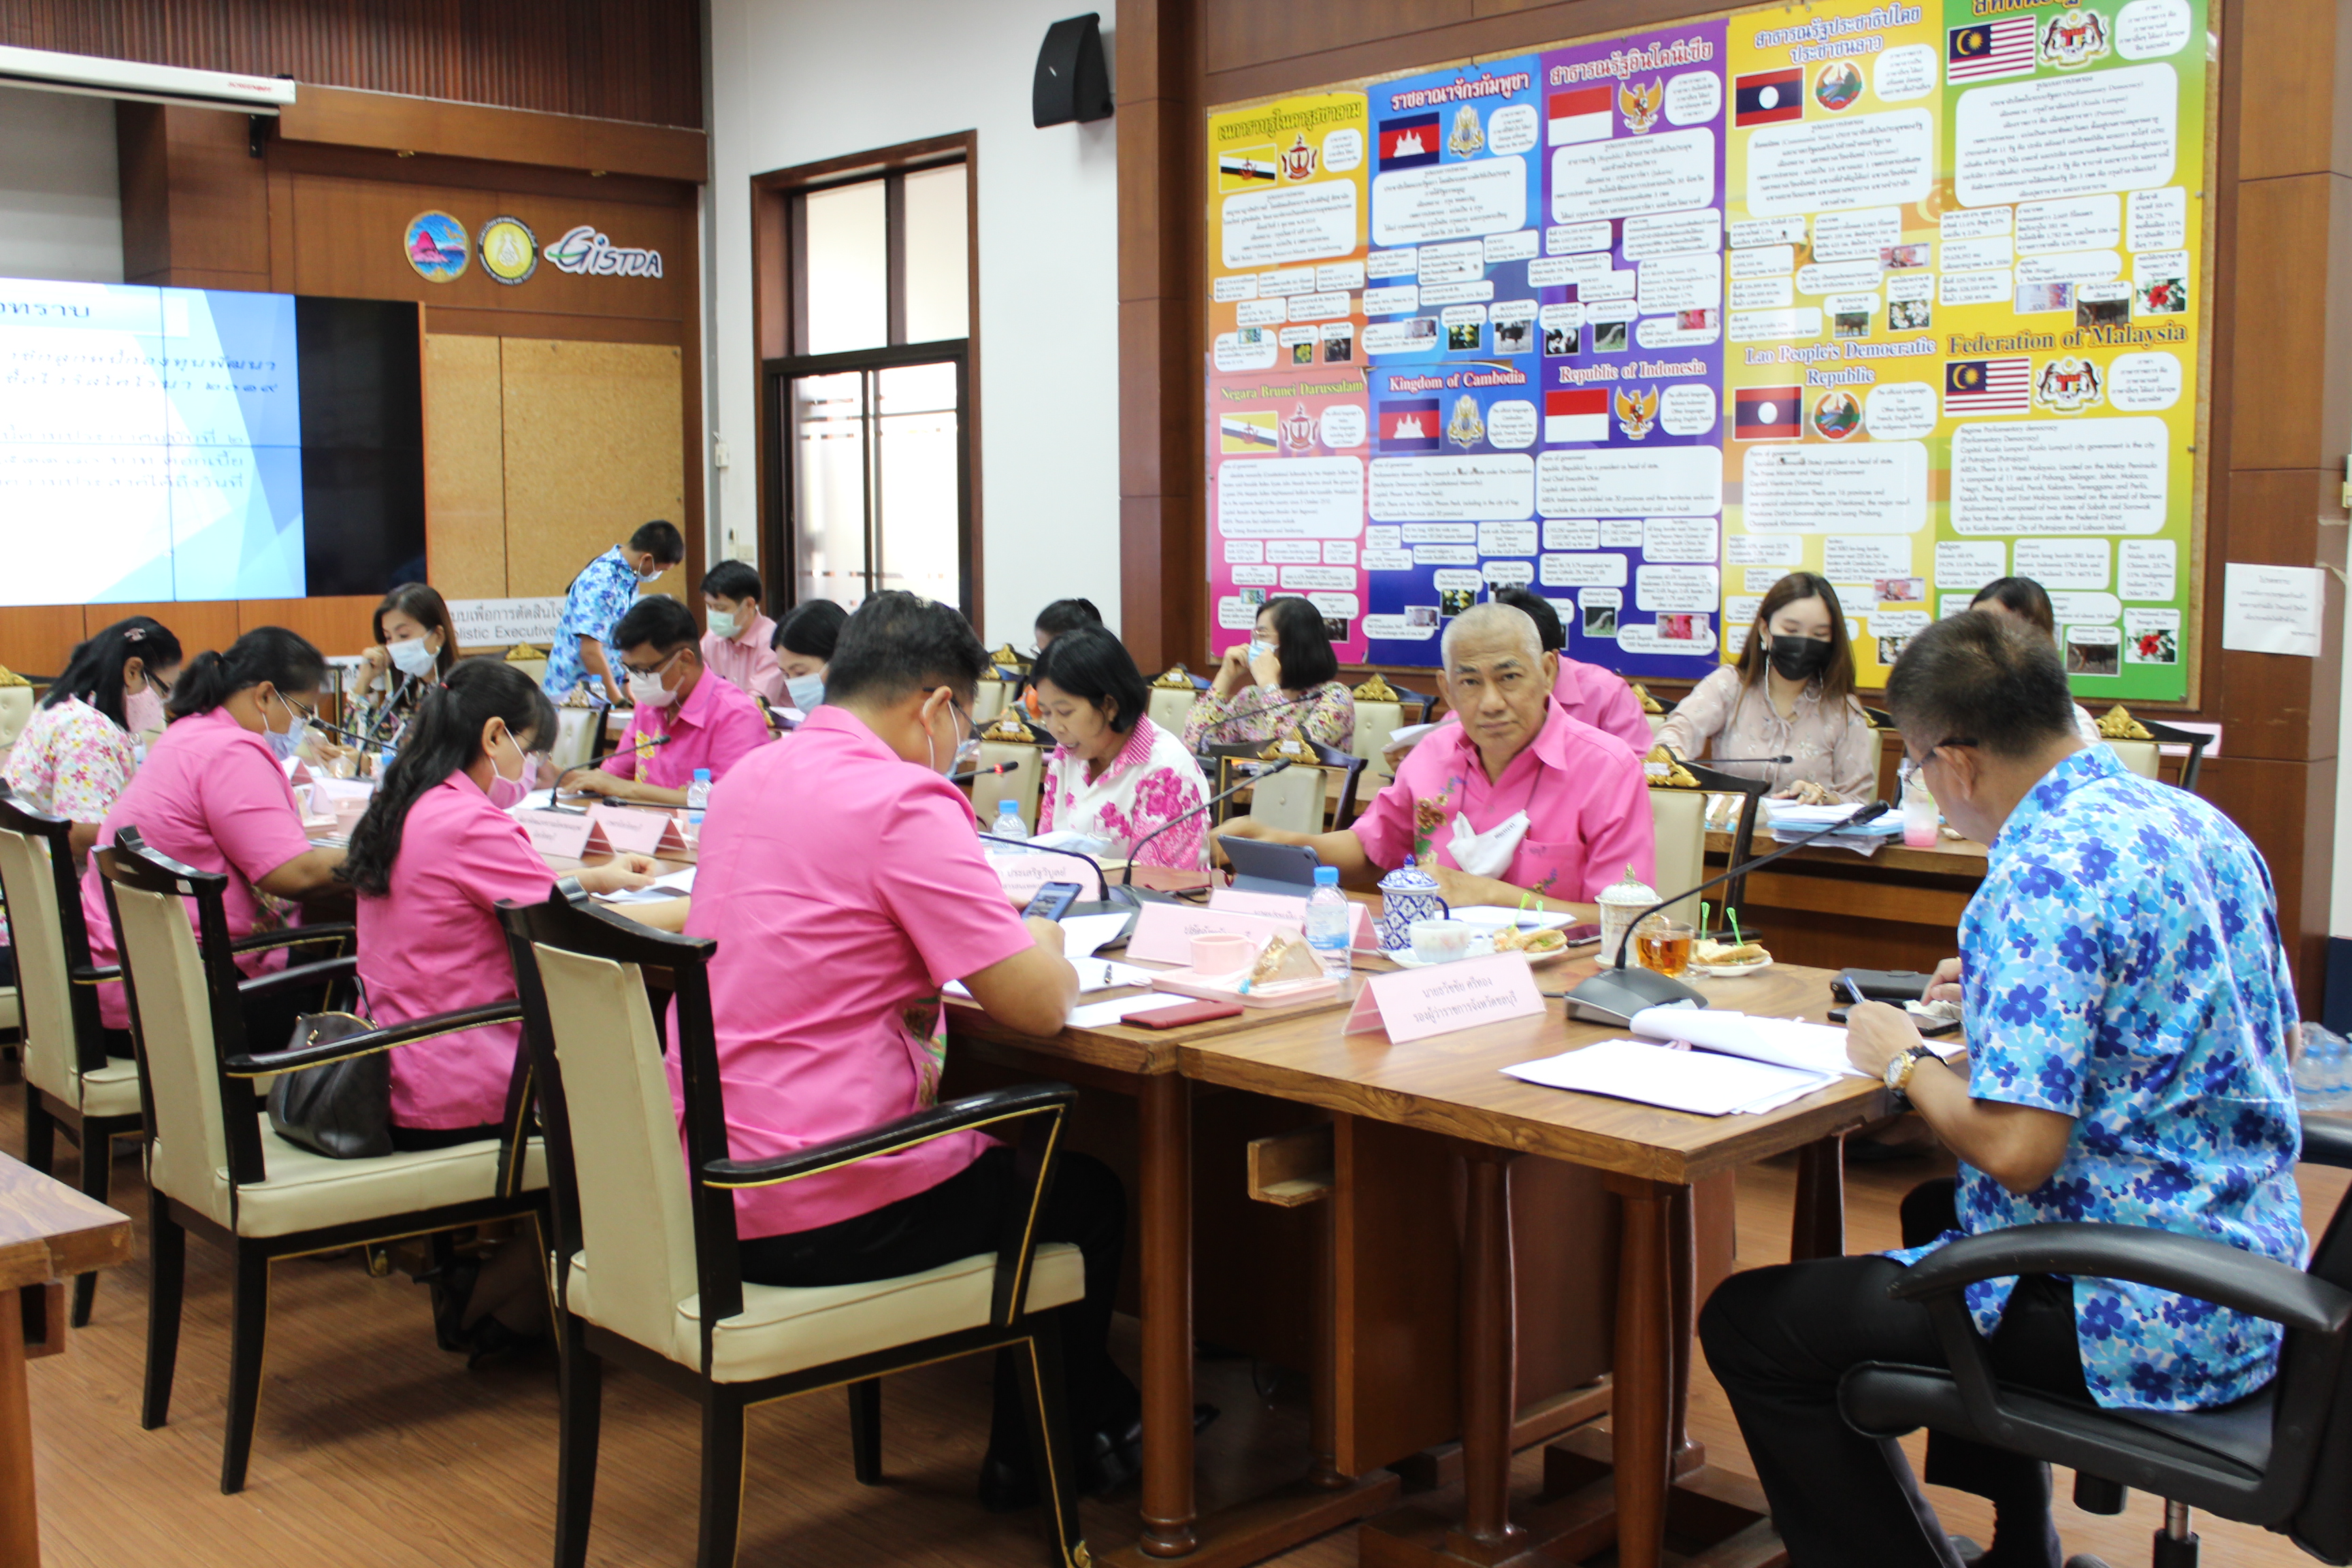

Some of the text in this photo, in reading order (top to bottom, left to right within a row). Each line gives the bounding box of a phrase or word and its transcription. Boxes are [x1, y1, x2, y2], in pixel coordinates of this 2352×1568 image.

[1392, 74, 1530, 110] ราชอาณาจักรกัมพูชา
[1744, 347, 1775, 365] Lao
[1844, 337, 1936, 359] Democratic
[1947, 321, 2187, 355] Federation of Malaysia
[1389, 371, 1526, 394] Kingdom of Cambodia
[1559, 358, 1707, 386] Republic of Indonesia
[1806, 365, 1875, 389] Republic
[1221, 387, 1257, 402] Negara
[1300, 380, 1363, 395] Darussalam
[455, 626, 489, 641] listic
